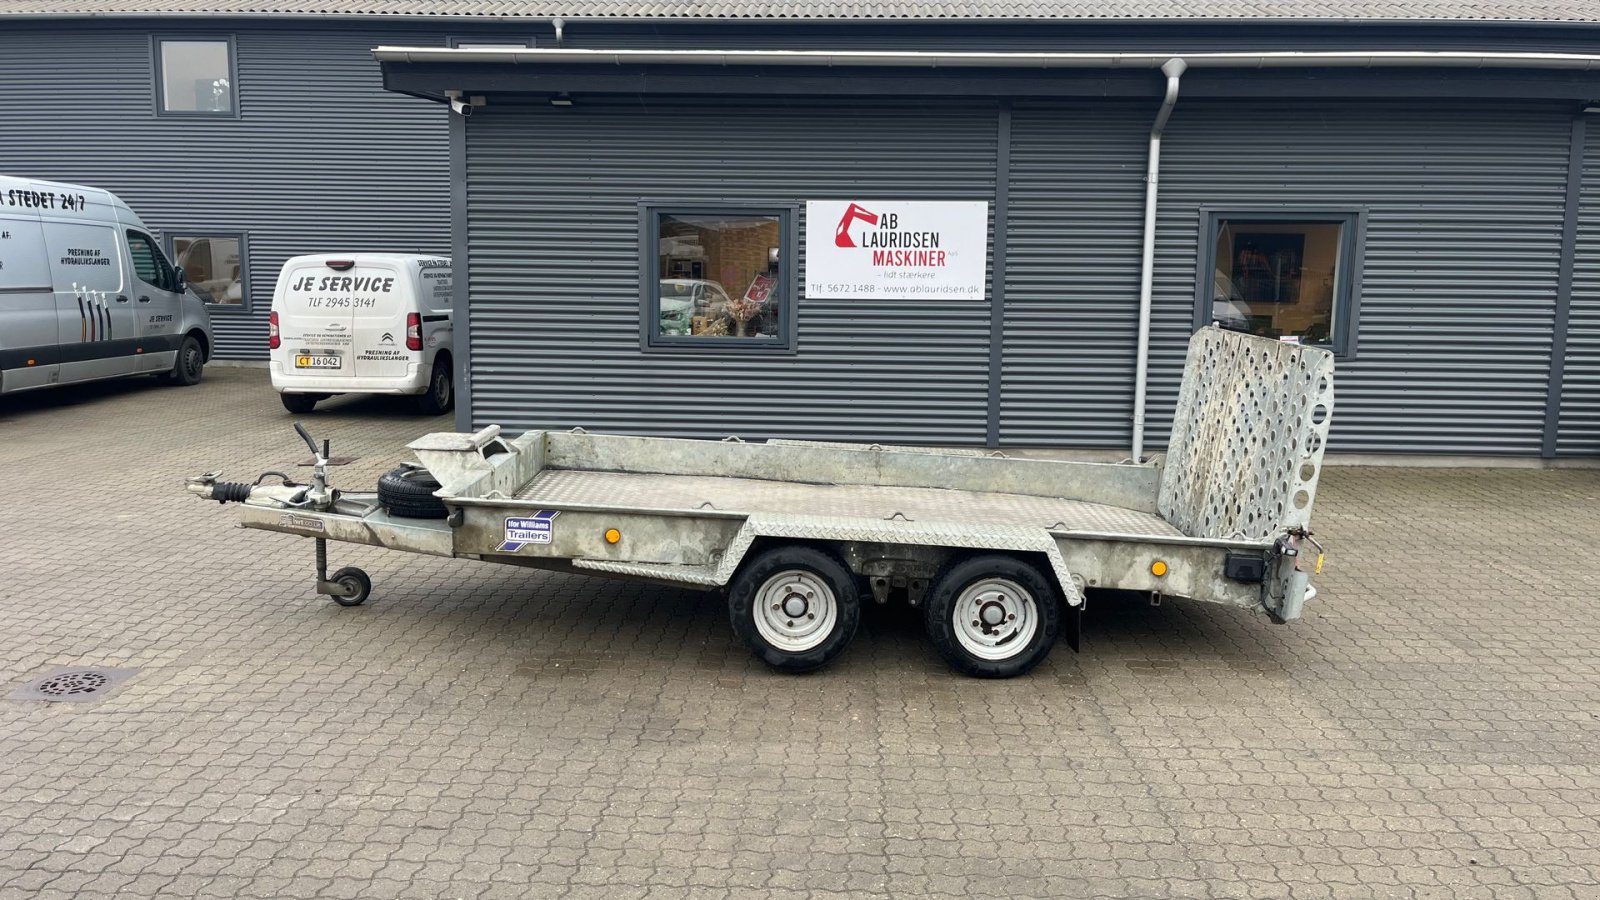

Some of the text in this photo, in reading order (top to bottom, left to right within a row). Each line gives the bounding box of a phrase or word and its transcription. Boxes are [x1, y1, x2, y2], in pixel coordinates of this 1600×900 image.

[8, 189, 55, 209] STEDET
[60, 193, 85, 212] 24/7
[880, 213, 898, 229] AB
[862, 231, 939, 248] LAURIDSEN
[94, 249, 101, 257] AF
[873, 250, 946, 267] MASKINER
[883, 270, 897, 279] lidt
[899, 271, 936, 279] stærkere
[293, 276, 395, 293] JE SERVICE
[827, 284, 850, 293] 5672
[852, 284, 875, 293] 1488
[883, 284, 979, 294] www.ablauridsen.dk
[308, 298, 376, 309] TLF 2945 3141
[299, 357, 338, 366] CT 16 042
[508, 520, 549, 529] Ifor Williams
[508, 529, 548, 540] Trailers
